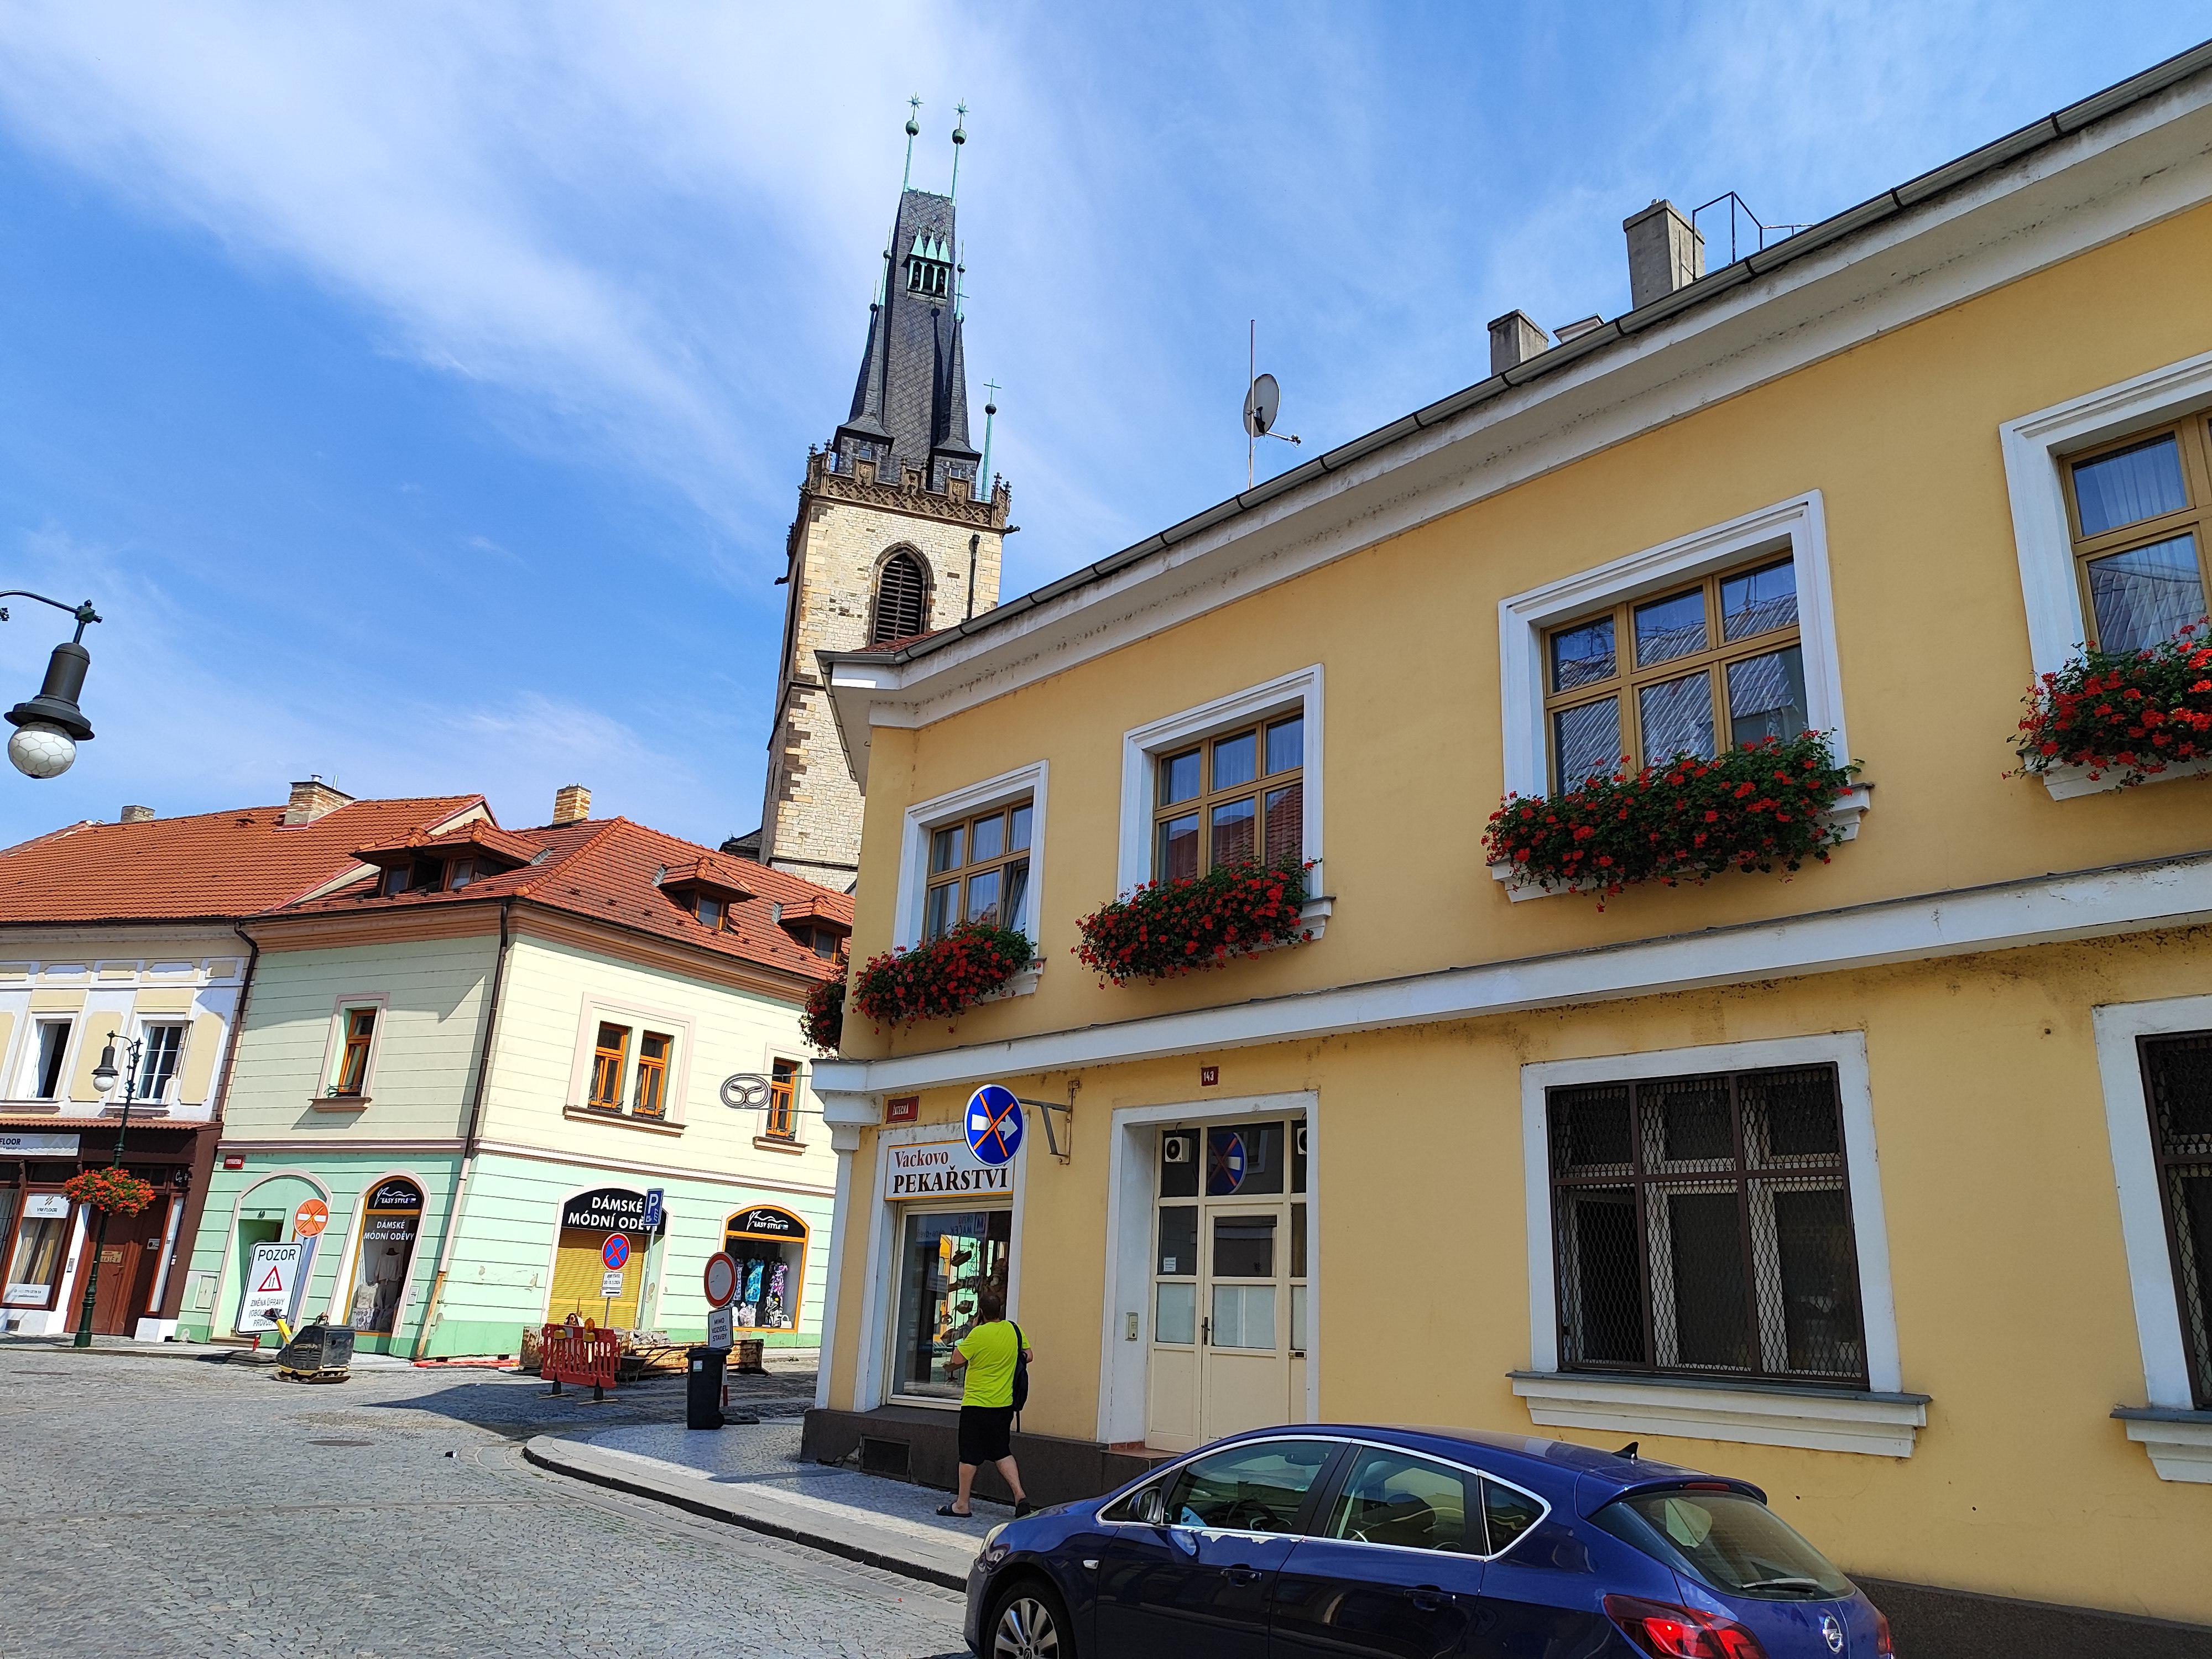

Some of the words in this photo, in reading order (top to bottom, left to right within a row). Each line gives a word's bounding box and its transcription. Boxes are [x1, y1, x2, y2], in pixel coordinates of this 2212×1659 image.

[1203, 1071, 1214, 1082] 143
[894, 1149, 949, 1168] Vackovo
[893, 1164, 1008, 1194] PEKAŘSTVÍ
[592, 1194, 643, 1213] DÁMSKÉ
[648, 1193, 659, 1214] P
[377, 1219, 406, 1229] DÁMSKÉ
[567, 1209, 616, 1228] MÓDNÍ
[363, 1230, 390, 1240] MÓDNÍ
[390, 1230, 415, 1241] ODĚVY
[258, 1249, 296, 1261] POZOR
[250, 1297, 266, 1307] ZMĚNA
[711, 1325, 728, 1334] VOZIDEL
[712, 1333, 728, 1342] STAVBY
